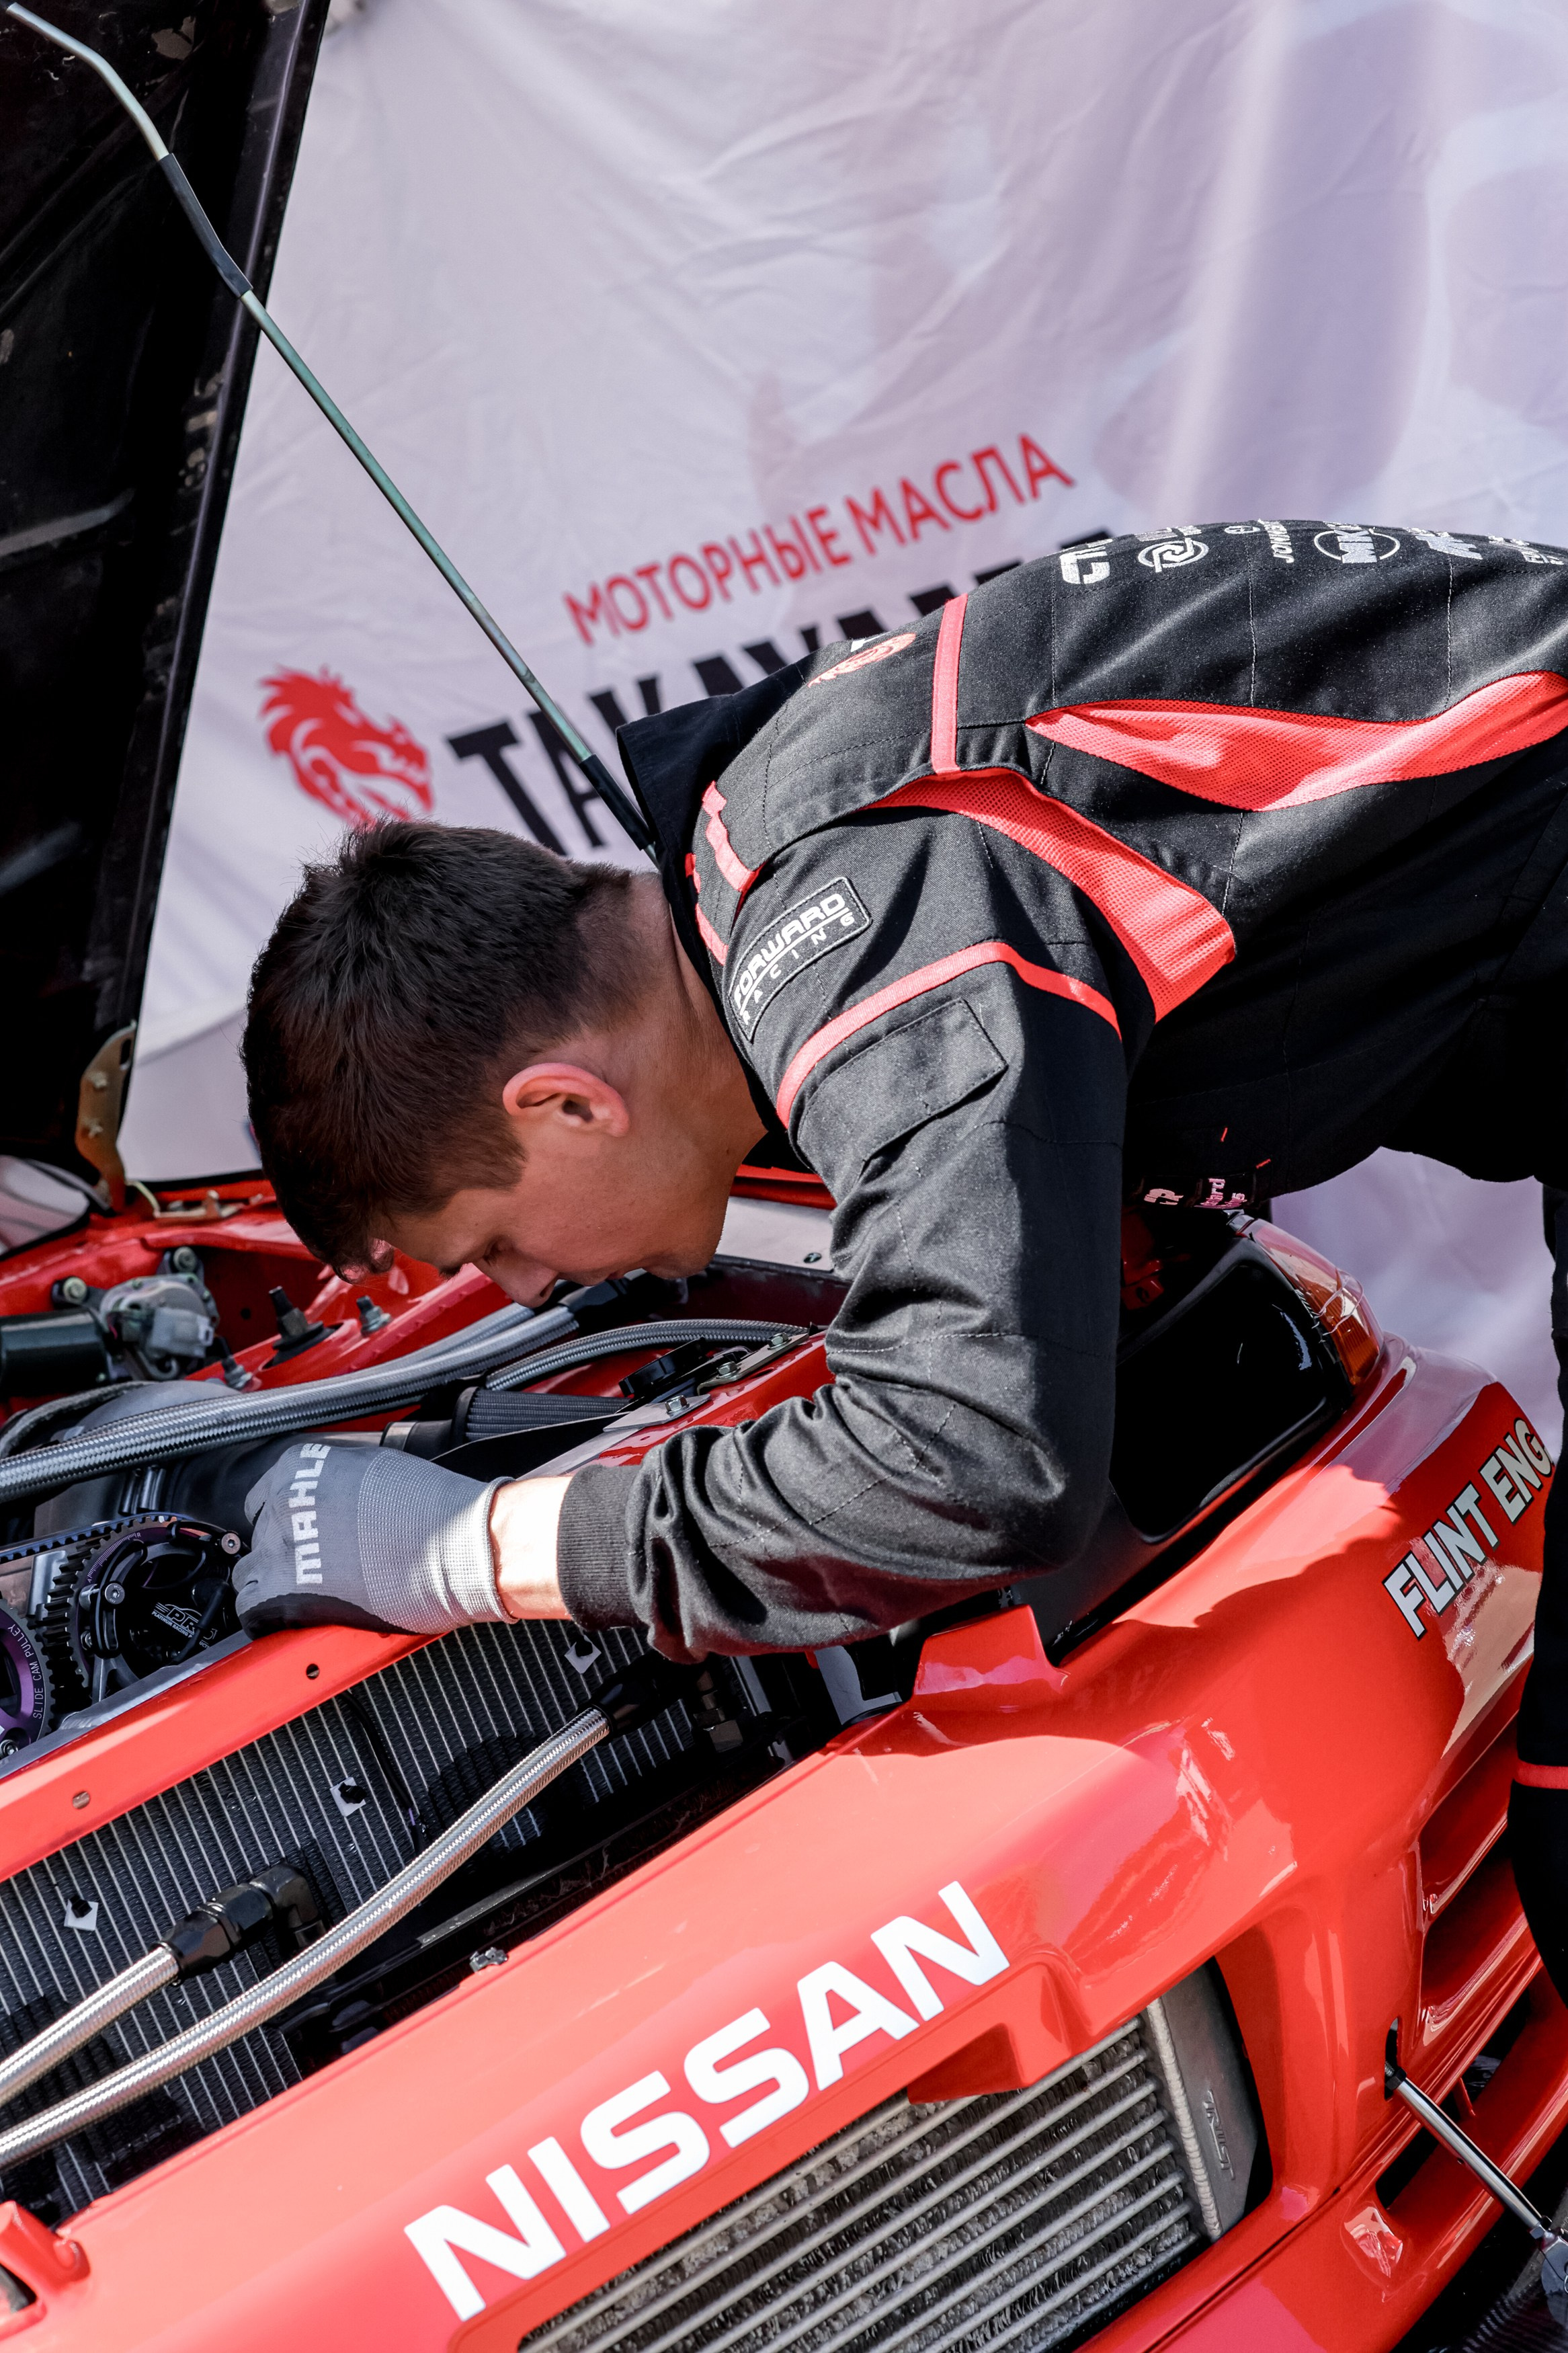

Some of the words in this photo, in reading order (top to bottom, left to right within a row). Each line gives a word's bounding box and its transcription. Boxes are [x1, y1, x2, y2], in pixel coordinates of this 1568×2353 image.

[563, 504, 852, 646] МОТОРНЫЕ
[844, 433, 1077, 557] МАСЛА
[734, 893, 845, 1009] FORWARD
[742, 912, 855, 1025] RACING
[288, 1443, 331, 1585] MAHLE
[1383, 1481, 1500, 1641] FLINT
[1479, 1417, 1555, 1525] ENG
[7, 1624, 34, 1658] PULLEY
[29, 1661, 42, 1681] CAM
[151, 1611, 173, 1627] PLATINUM
[172, 1623, 189, 1636] RACING
[33, 1687, 44, 1719] SLIDE
[404, 1881, 1010, 2322] NISSAN
